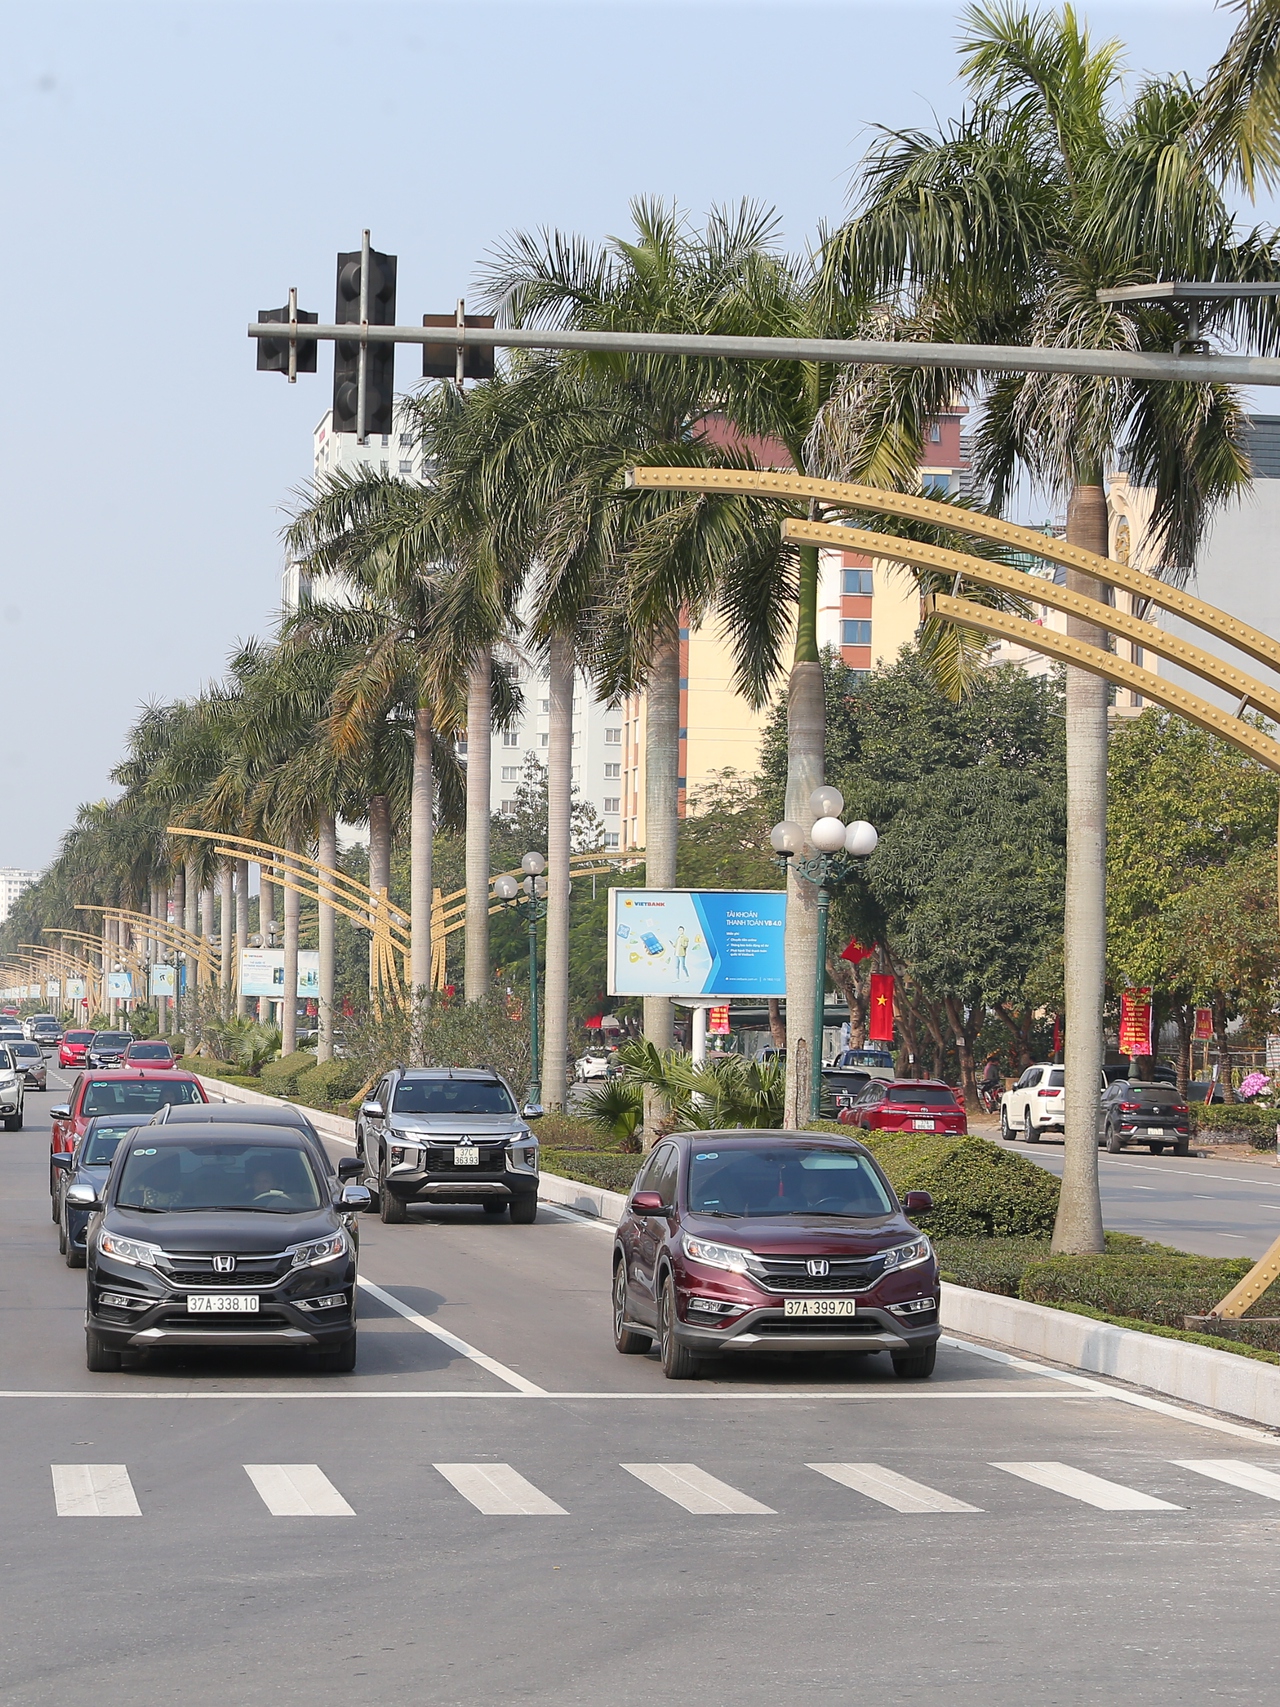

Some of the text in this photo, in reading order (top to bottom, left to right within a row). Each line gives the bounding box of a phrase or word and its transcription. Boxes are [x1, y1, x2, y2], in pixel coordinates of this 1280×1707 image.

[460, 1148, 473, 1156] 37C
[190, 1297, 257, 1311] 37A-338.10
[786, 1301, 853, 1315] 37A-399.70
